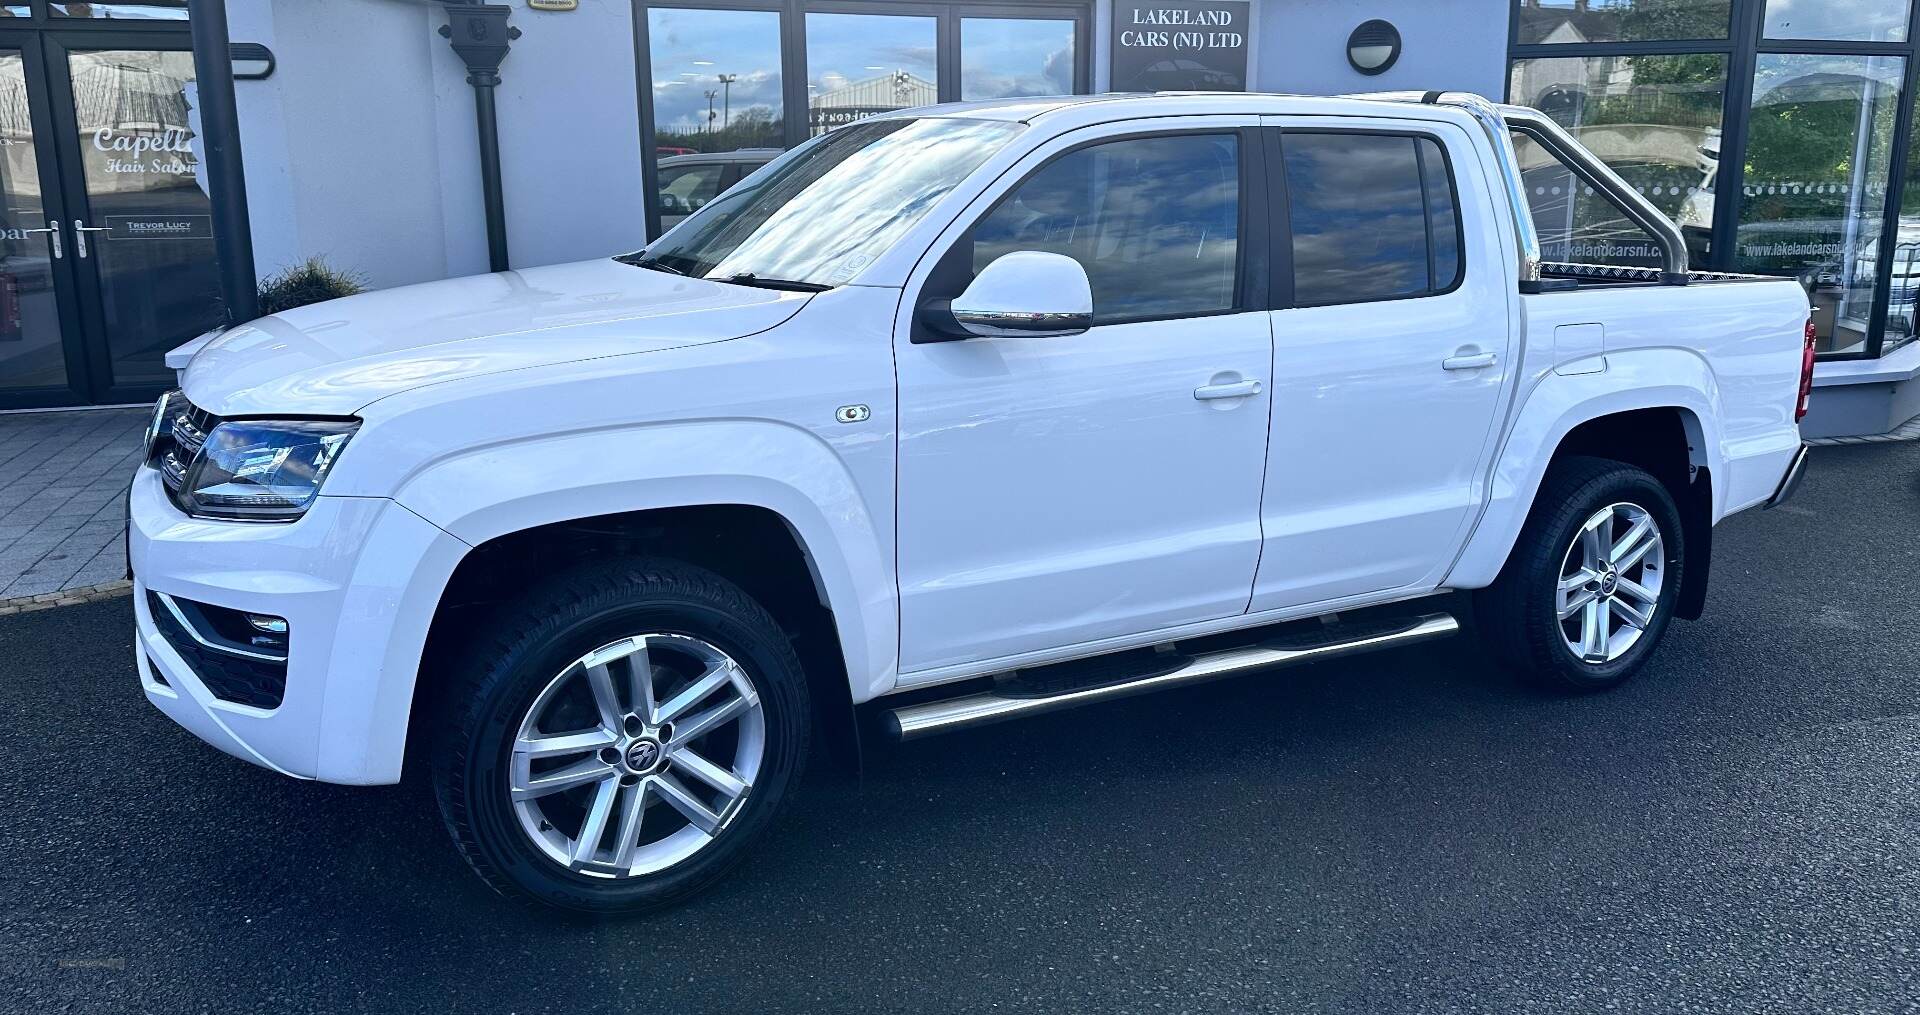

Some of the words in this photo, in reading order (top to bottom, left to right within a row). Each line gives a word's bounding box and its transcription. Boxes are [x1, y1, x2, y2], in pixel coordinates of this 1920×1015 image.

[1133, 9, 1232, 26] LAKELAND
[1120, 31, 1169, 47] CARS
[1173, 32, 1204, 50] (NI)
[1208, 33, 1242, 48] LTD
[105, 159, 146, 173] Hair
